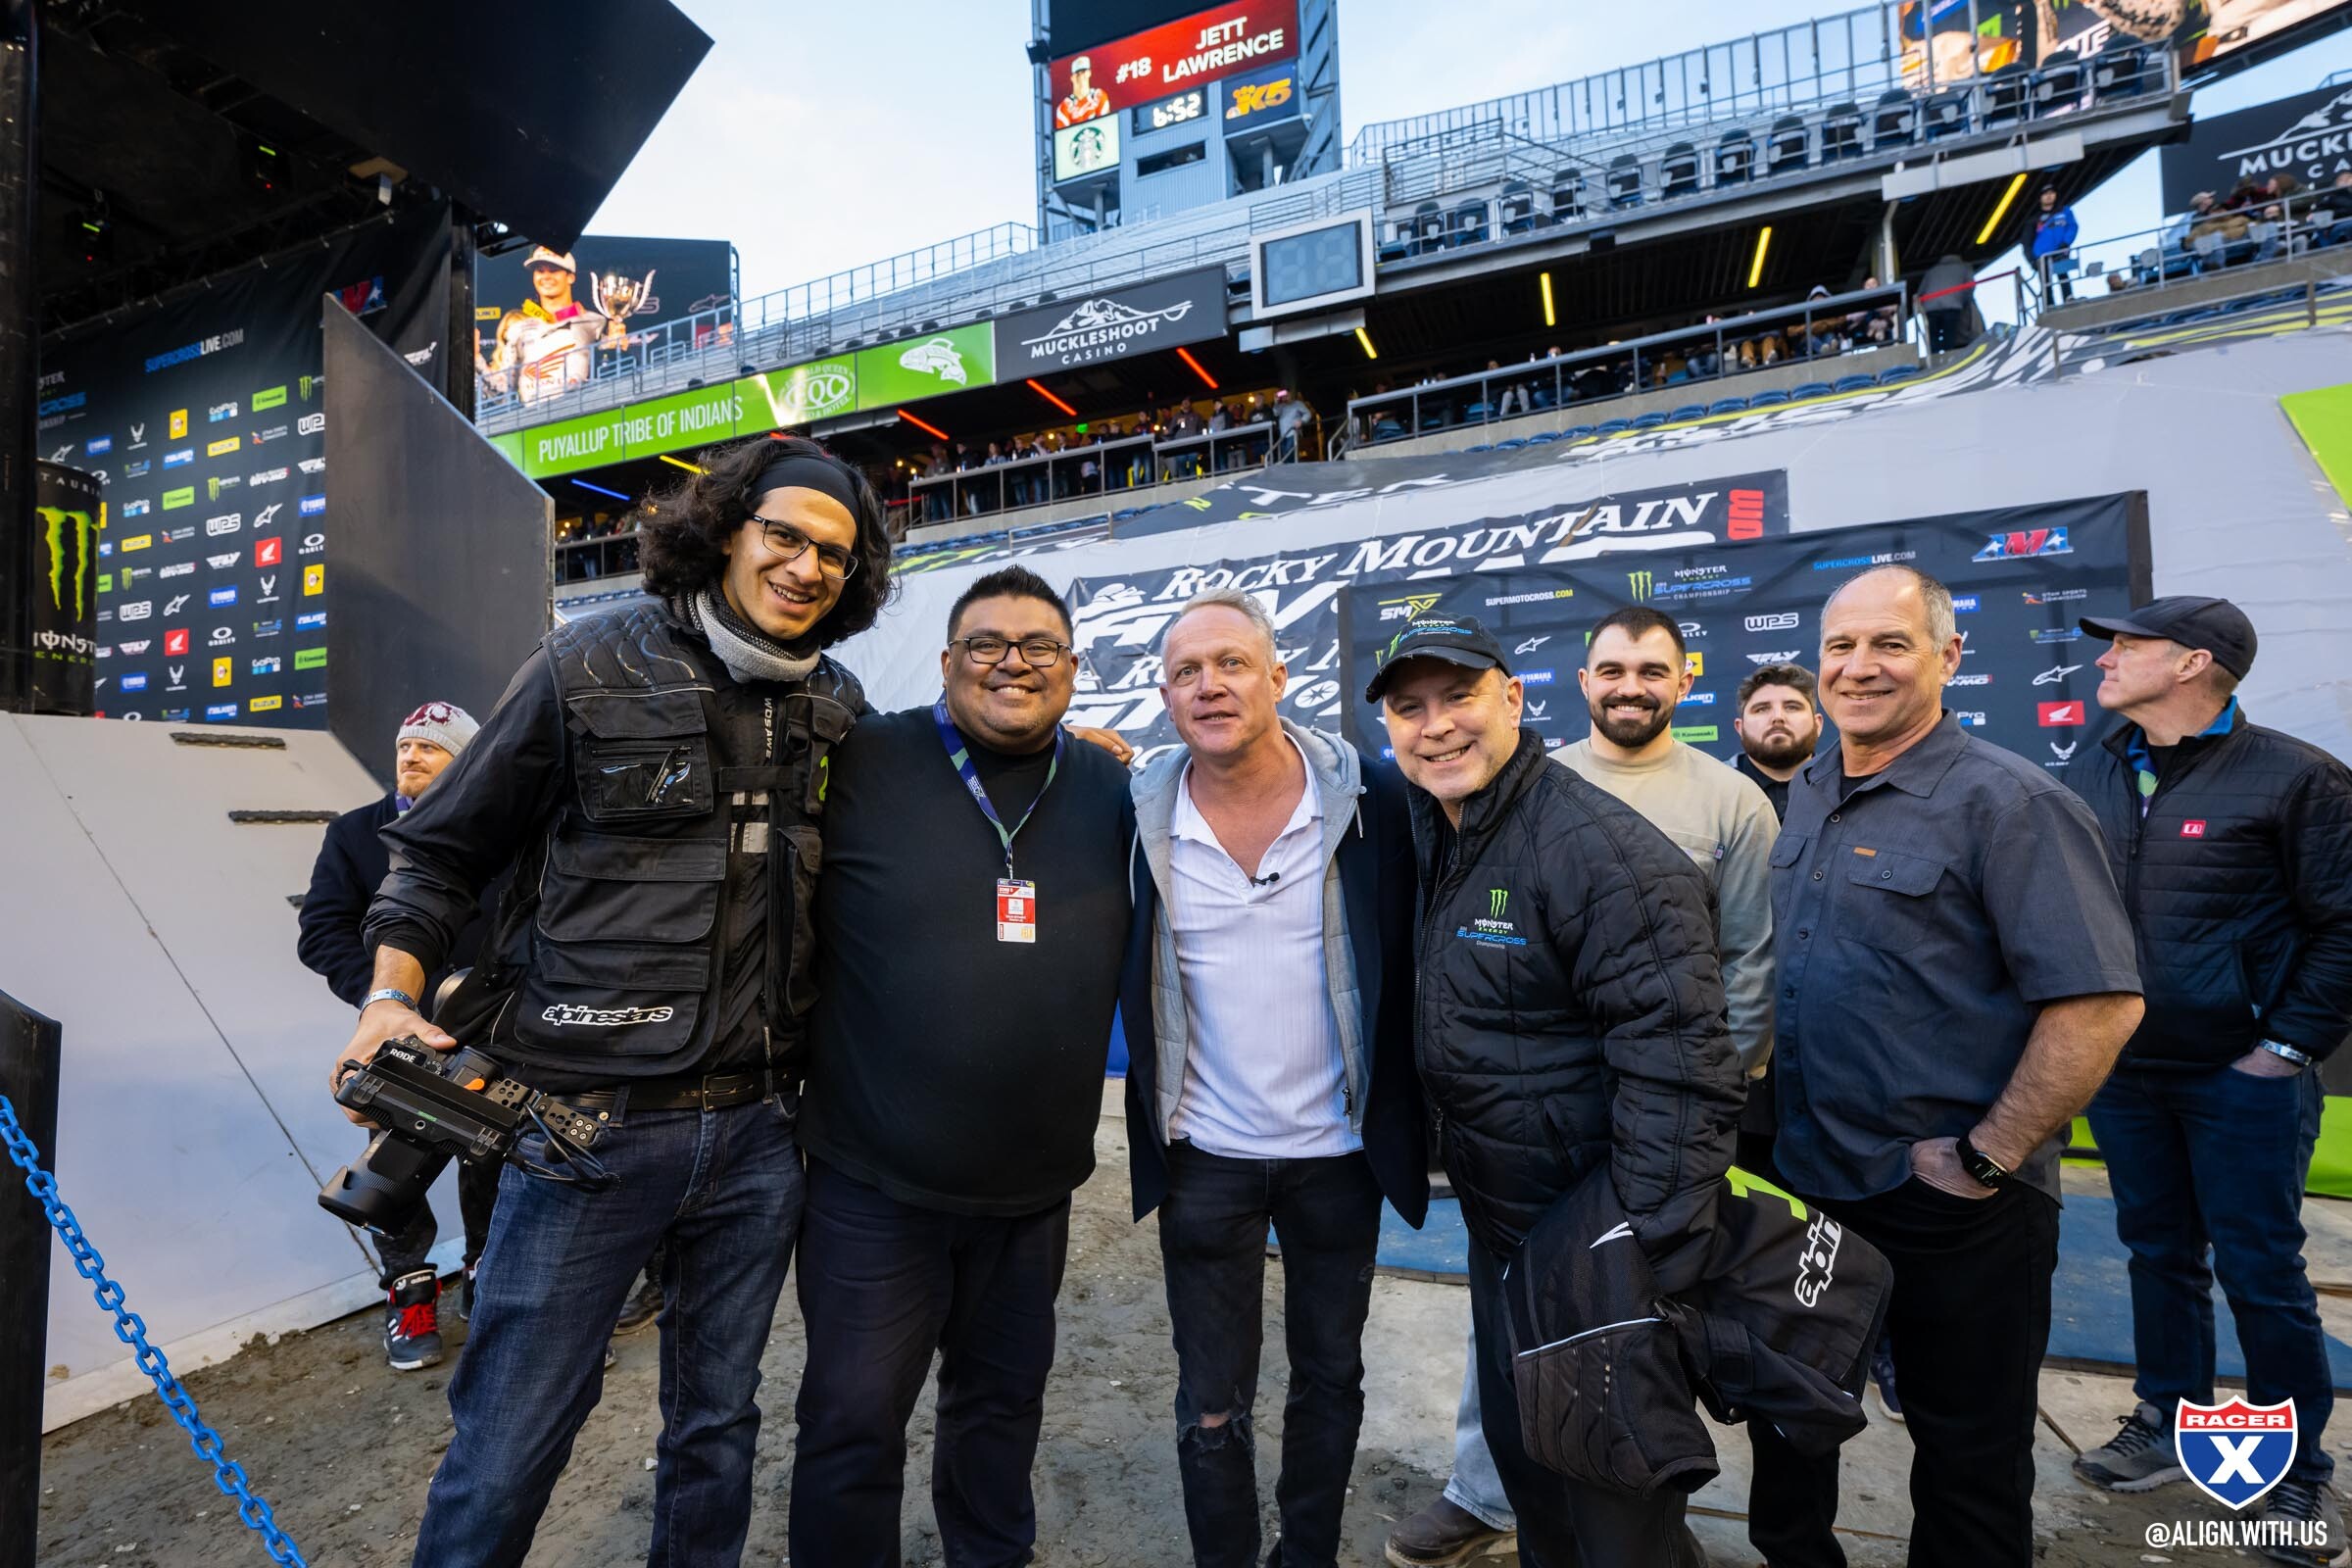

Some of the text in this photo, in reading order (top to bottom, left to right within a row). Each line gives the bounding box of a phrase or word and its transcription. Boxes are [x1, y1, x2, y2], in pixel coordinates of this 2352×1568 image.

[1196, 16, 1248, 50] JETT
[1162, 28, 1284, 83] LAWRENCE
[1115, 57, 1152, 84] #18
[1152, 93, 1201, 128] 6:52
[1030, 317, 1159, 359] MUCKLESHOOT
[1061, 342, 1128, 366] CASINO
[794, 373, 850, 408] QC
[539, 396, 743, 464] PUYALLUP TRIBE OF INDIANS
[206, 513, 241, 537] WPS
[1154, 492, 1718, 602] ROCKY MOUNTAIN
[1971, 526, 2070, 559] AMA
[1674, 564, 1728, 578] MONSTER
[1813, 551, 1917, 570] SUPERCROSSLIVE.COM
[1654, 576, 1752, 595] SUPERCROSS
[1674, 589, 1731, 601] CHAMPIONSHIP
[1379, 594, 1441, 622] SMX
[1486, 589, 1574, 607] SUPERMOTOCROSS.COM
[1745, 612, 1799, 632] WPS
[33, 629, 96, 654] ONST
[763, 698, 773, 760] WOSAWE
[1474, 918, 1514, 930] MONSTER
[1456, 930, 1528, 946] SUPERCROSS
[542, 1004, 673, 1026] alpinestars
[390, 1048, 416, 1063] RØDE
[411, 1275, 431, 1285] adidas
